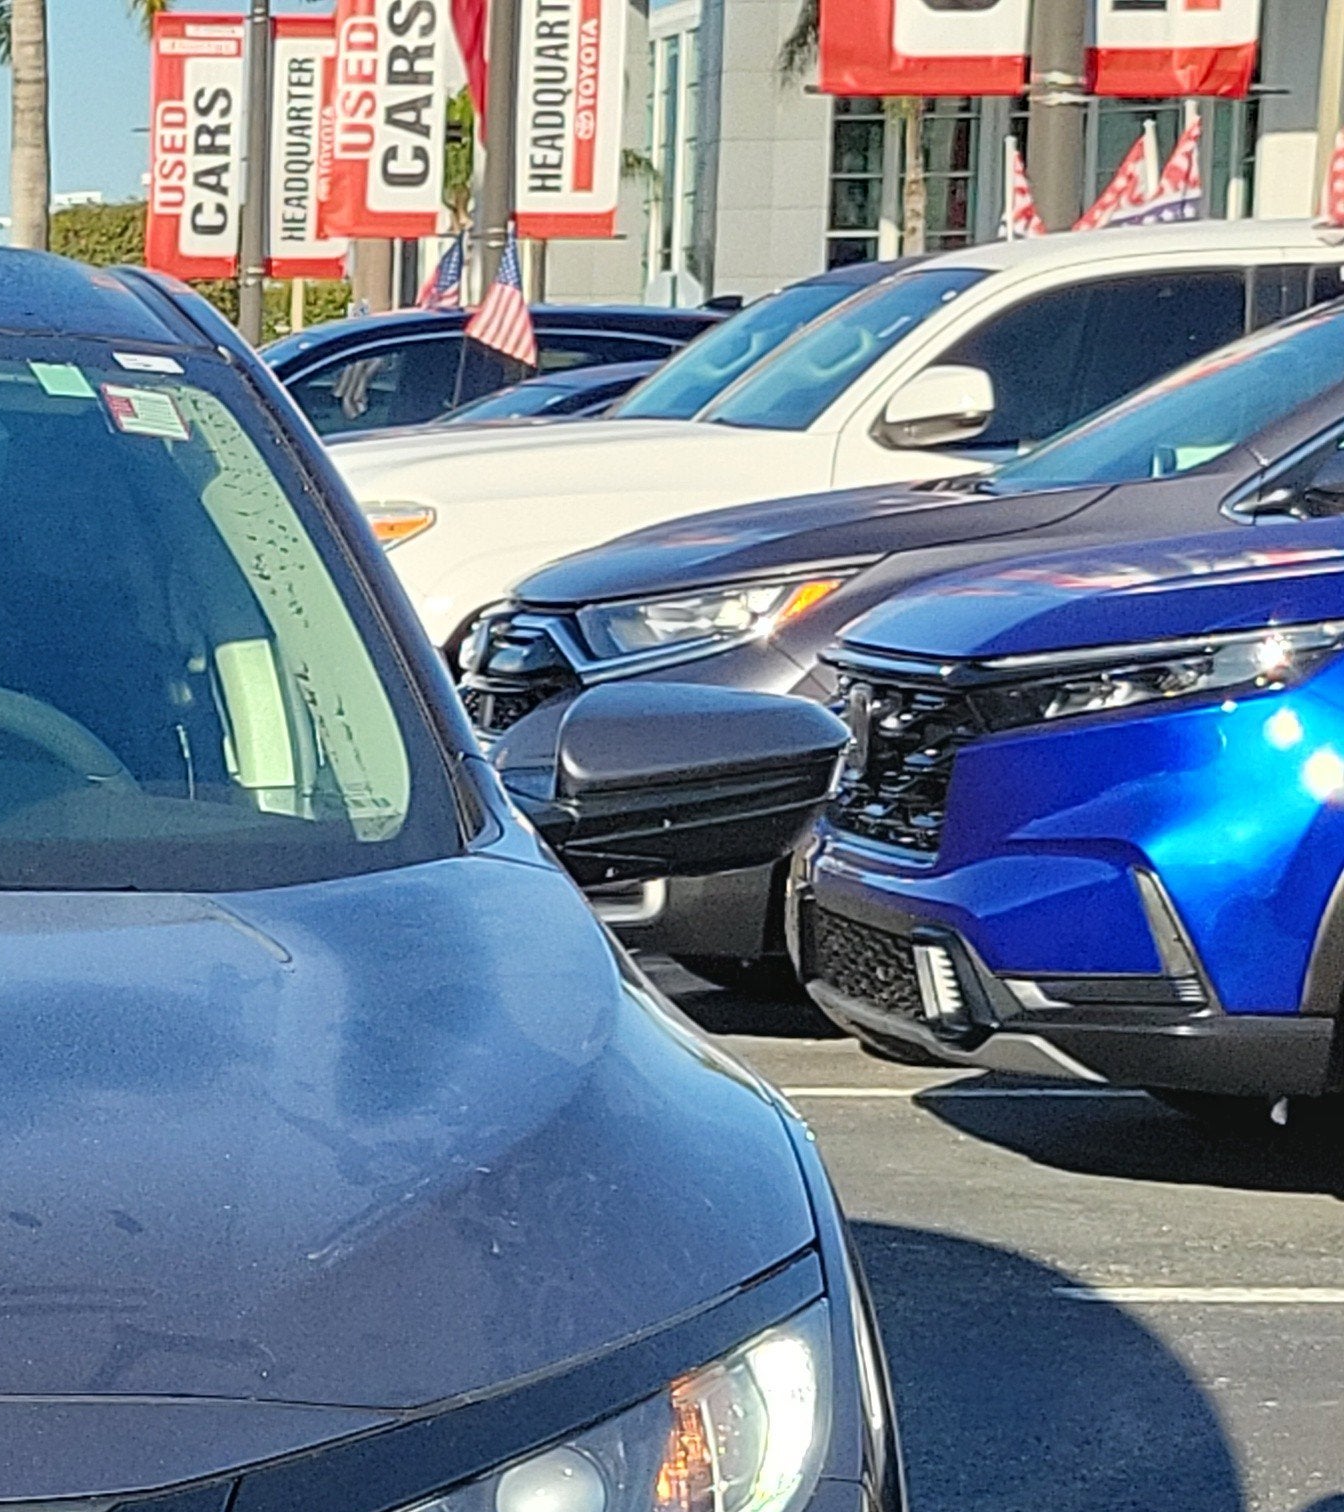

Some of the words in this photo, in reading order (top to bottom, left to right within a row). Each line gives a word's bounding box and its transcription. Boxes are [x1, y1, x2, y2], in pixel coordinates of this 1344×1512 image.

[340, 24, 380, 153] USED
[381, 0, 437, 188] CARS
[578, 18, 598, 109] TOYOTA
[159, 106, 187, 209] USED
[190, 87, 233, 236] CARS
[281, 57, 315, 242] HEADQUARTER
